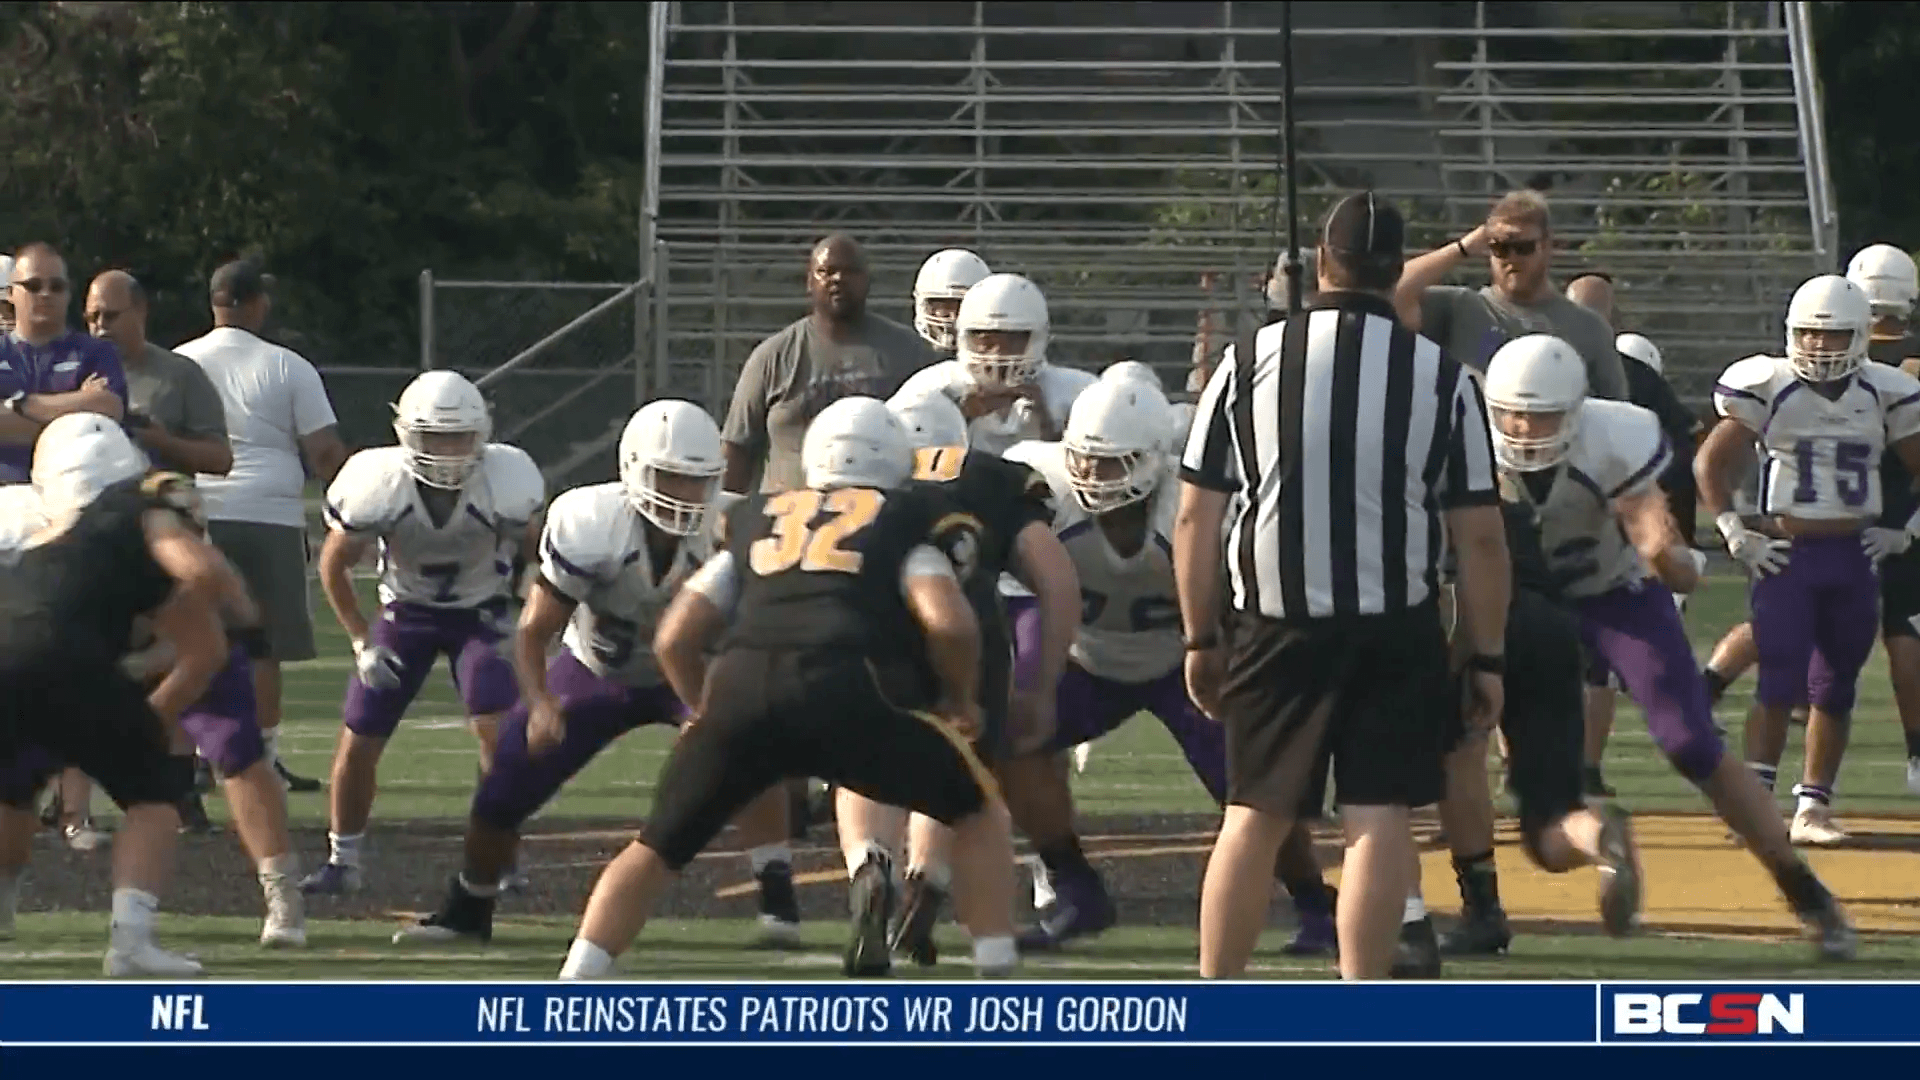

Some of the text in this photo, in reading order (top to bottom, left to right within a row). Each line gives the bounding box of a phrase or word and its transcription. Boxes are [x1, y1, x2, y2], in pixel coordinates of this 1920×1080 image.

[1793, 440, 1872, 506] 15
[750, 487, 886, 576] 32
[420, 562, 461, 601] 7
